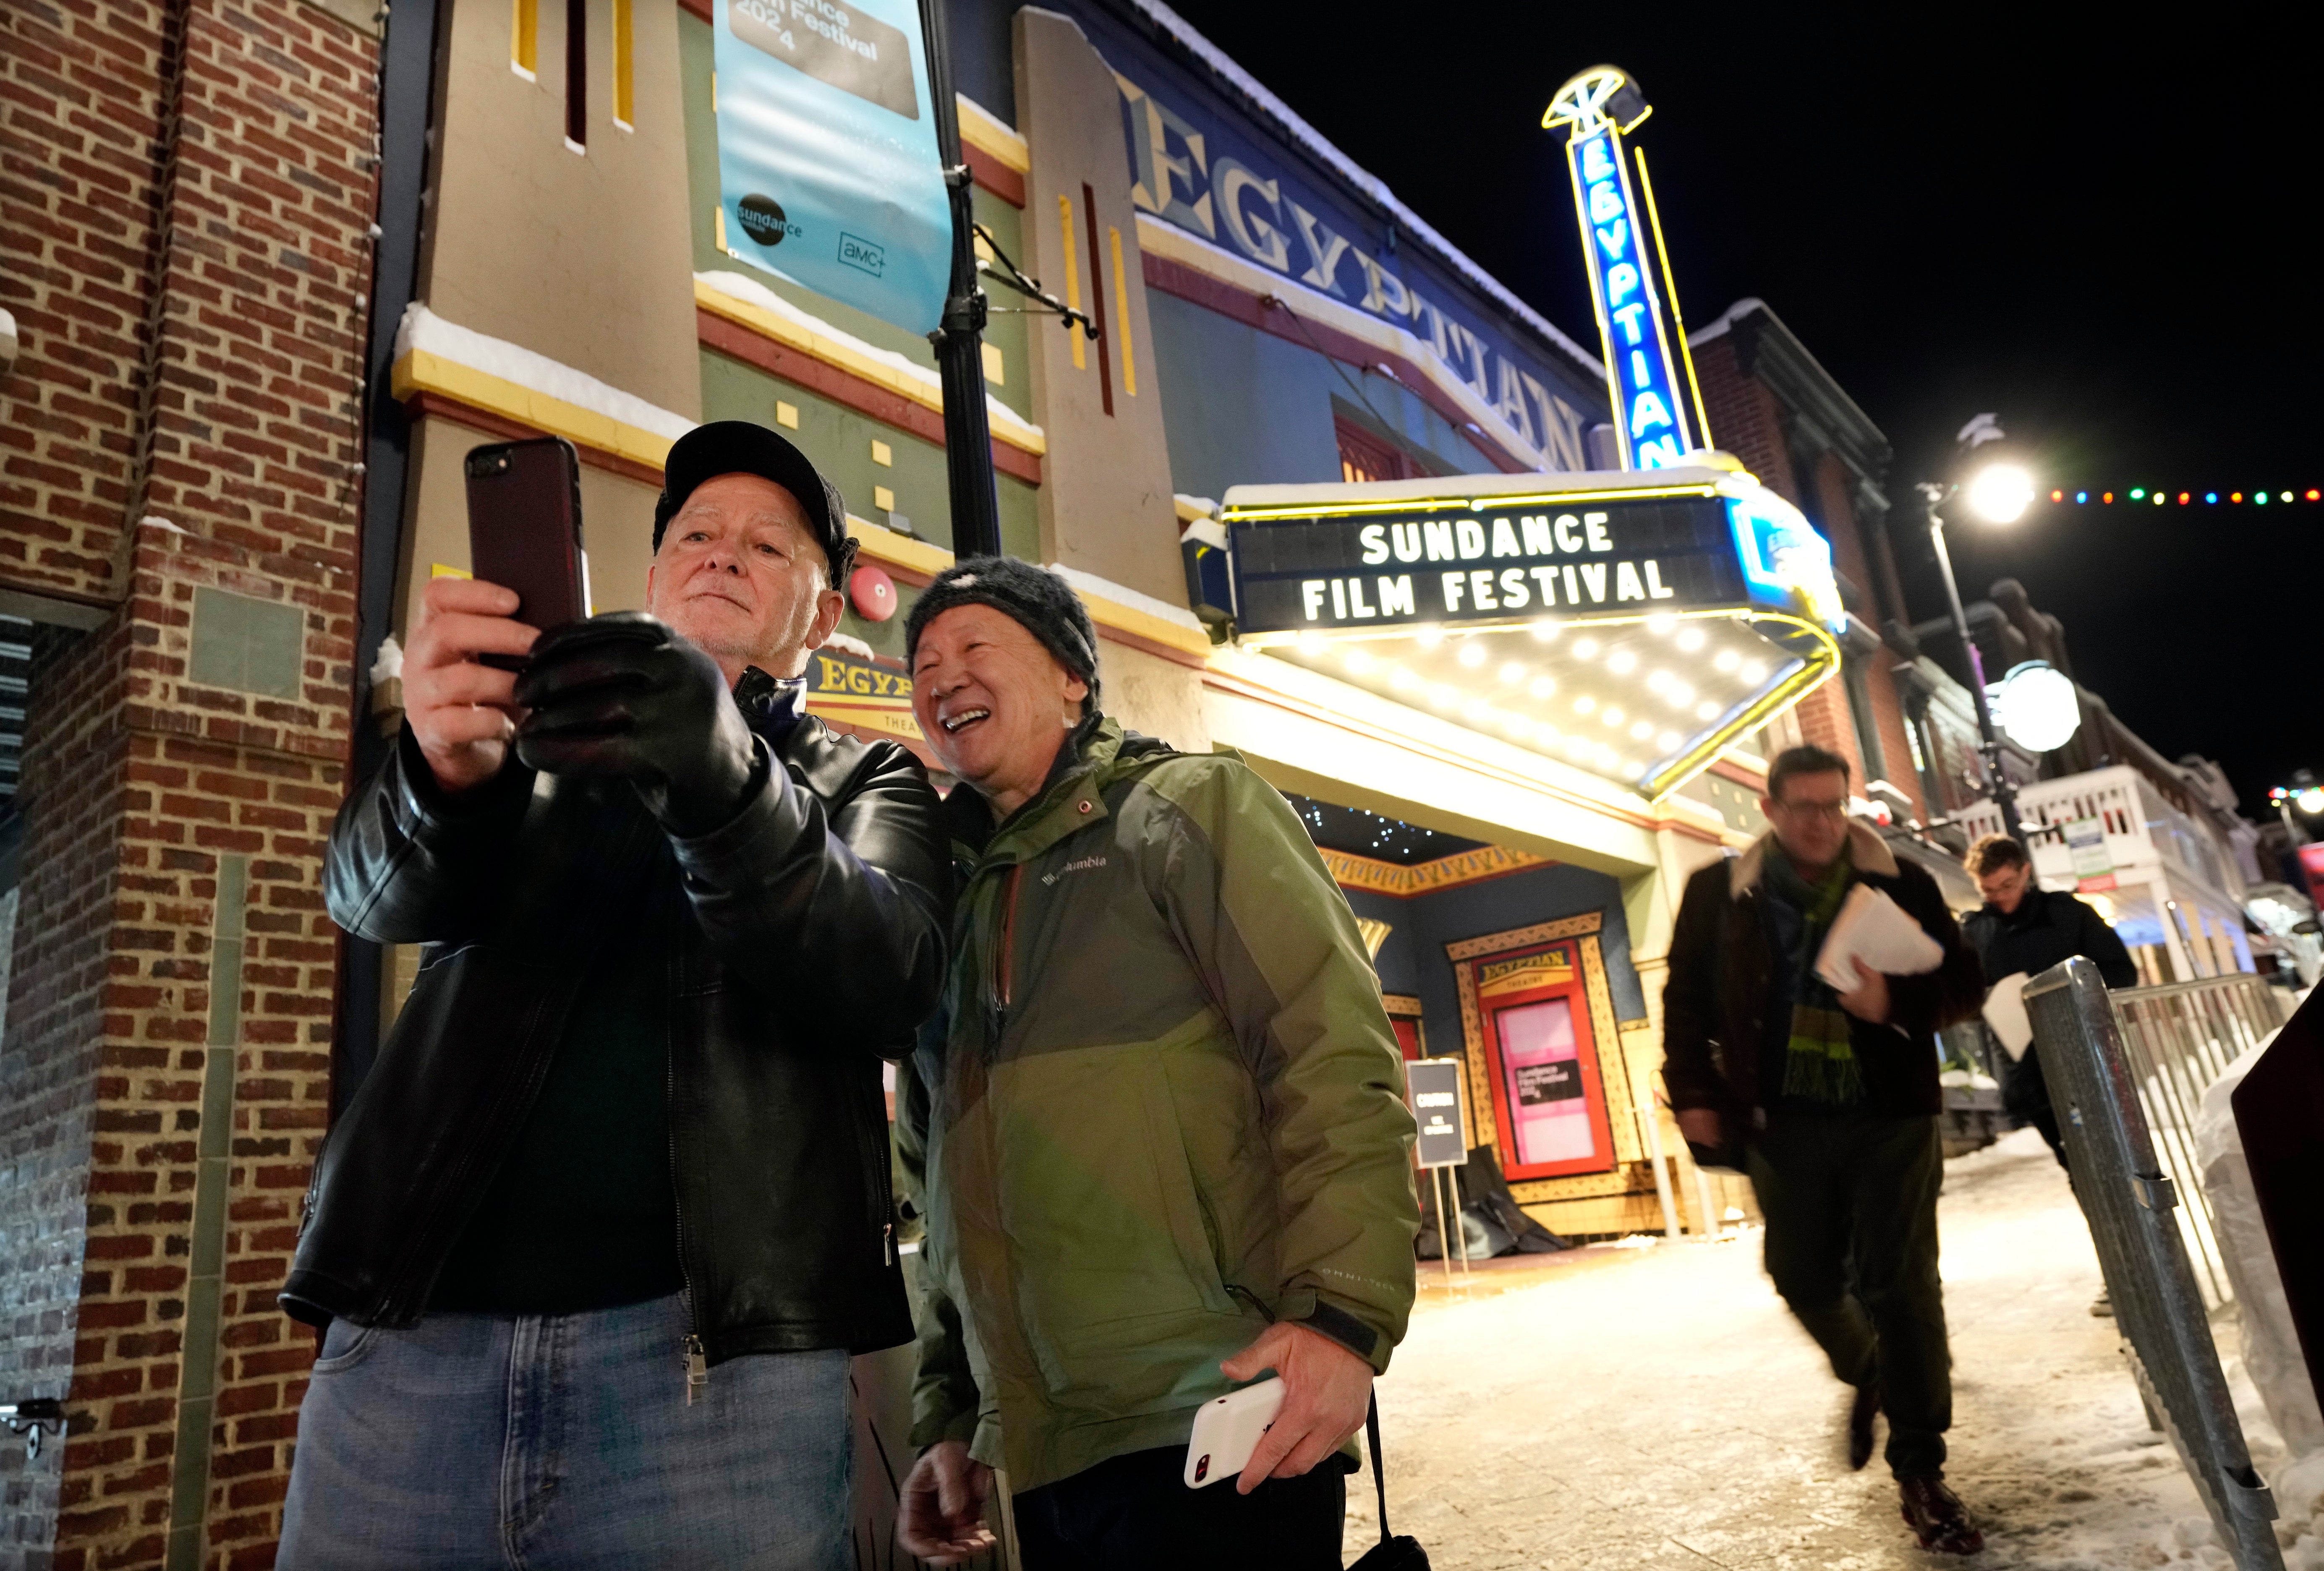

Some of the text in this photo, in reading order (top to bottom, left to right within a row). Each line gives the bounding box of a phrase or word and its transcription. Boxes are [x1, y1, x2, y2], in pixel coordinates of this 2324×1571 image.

[791, 2, 878, 61] Festival
[737, 206, 802, 238] sundance
[1115, 72, 1587, 471] EGYPTIAN
[1582, 137, 1683, 470] EGYPTIAN
[1359, 512, 1613, 564] SUNDANCE
[1302, 560, 1674, 621] FILM FESTIVAL
[817, 655, 913, 696] EGYP
[884, 715, 921, 733] THEA
[1056, 856, 1106, 880] lumbia
